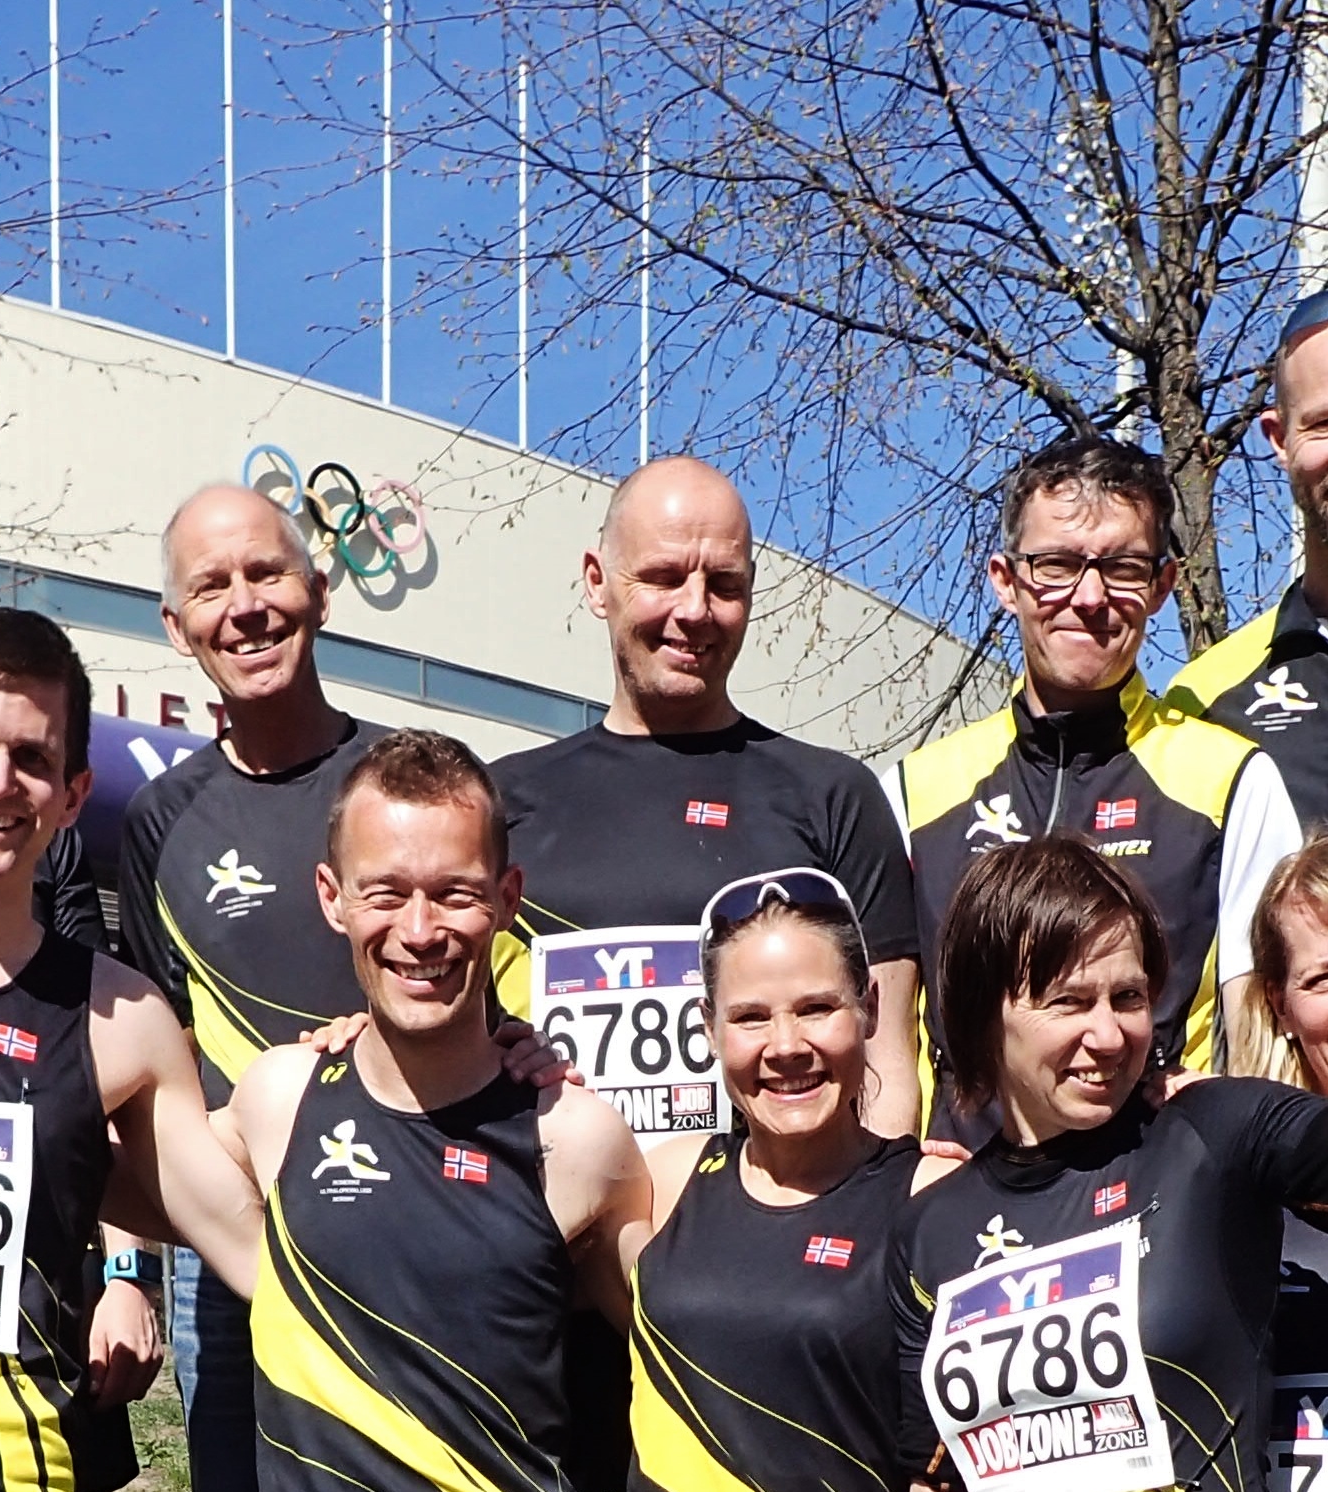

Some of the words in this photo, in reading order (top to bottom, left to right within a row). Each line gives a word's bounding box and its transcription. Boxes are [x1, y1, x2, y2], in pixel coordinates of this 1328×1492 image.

[594, 947, 654, 988] YT
[542, 996, 716, 1077] 6786
[673, 1113, 716, 1130] ZONE
[1000, 1263, 1062, 1313] YT
[934, 1301, 1128, 1422] 6786
[1094, 1430, 1147, 1453] ZONE
